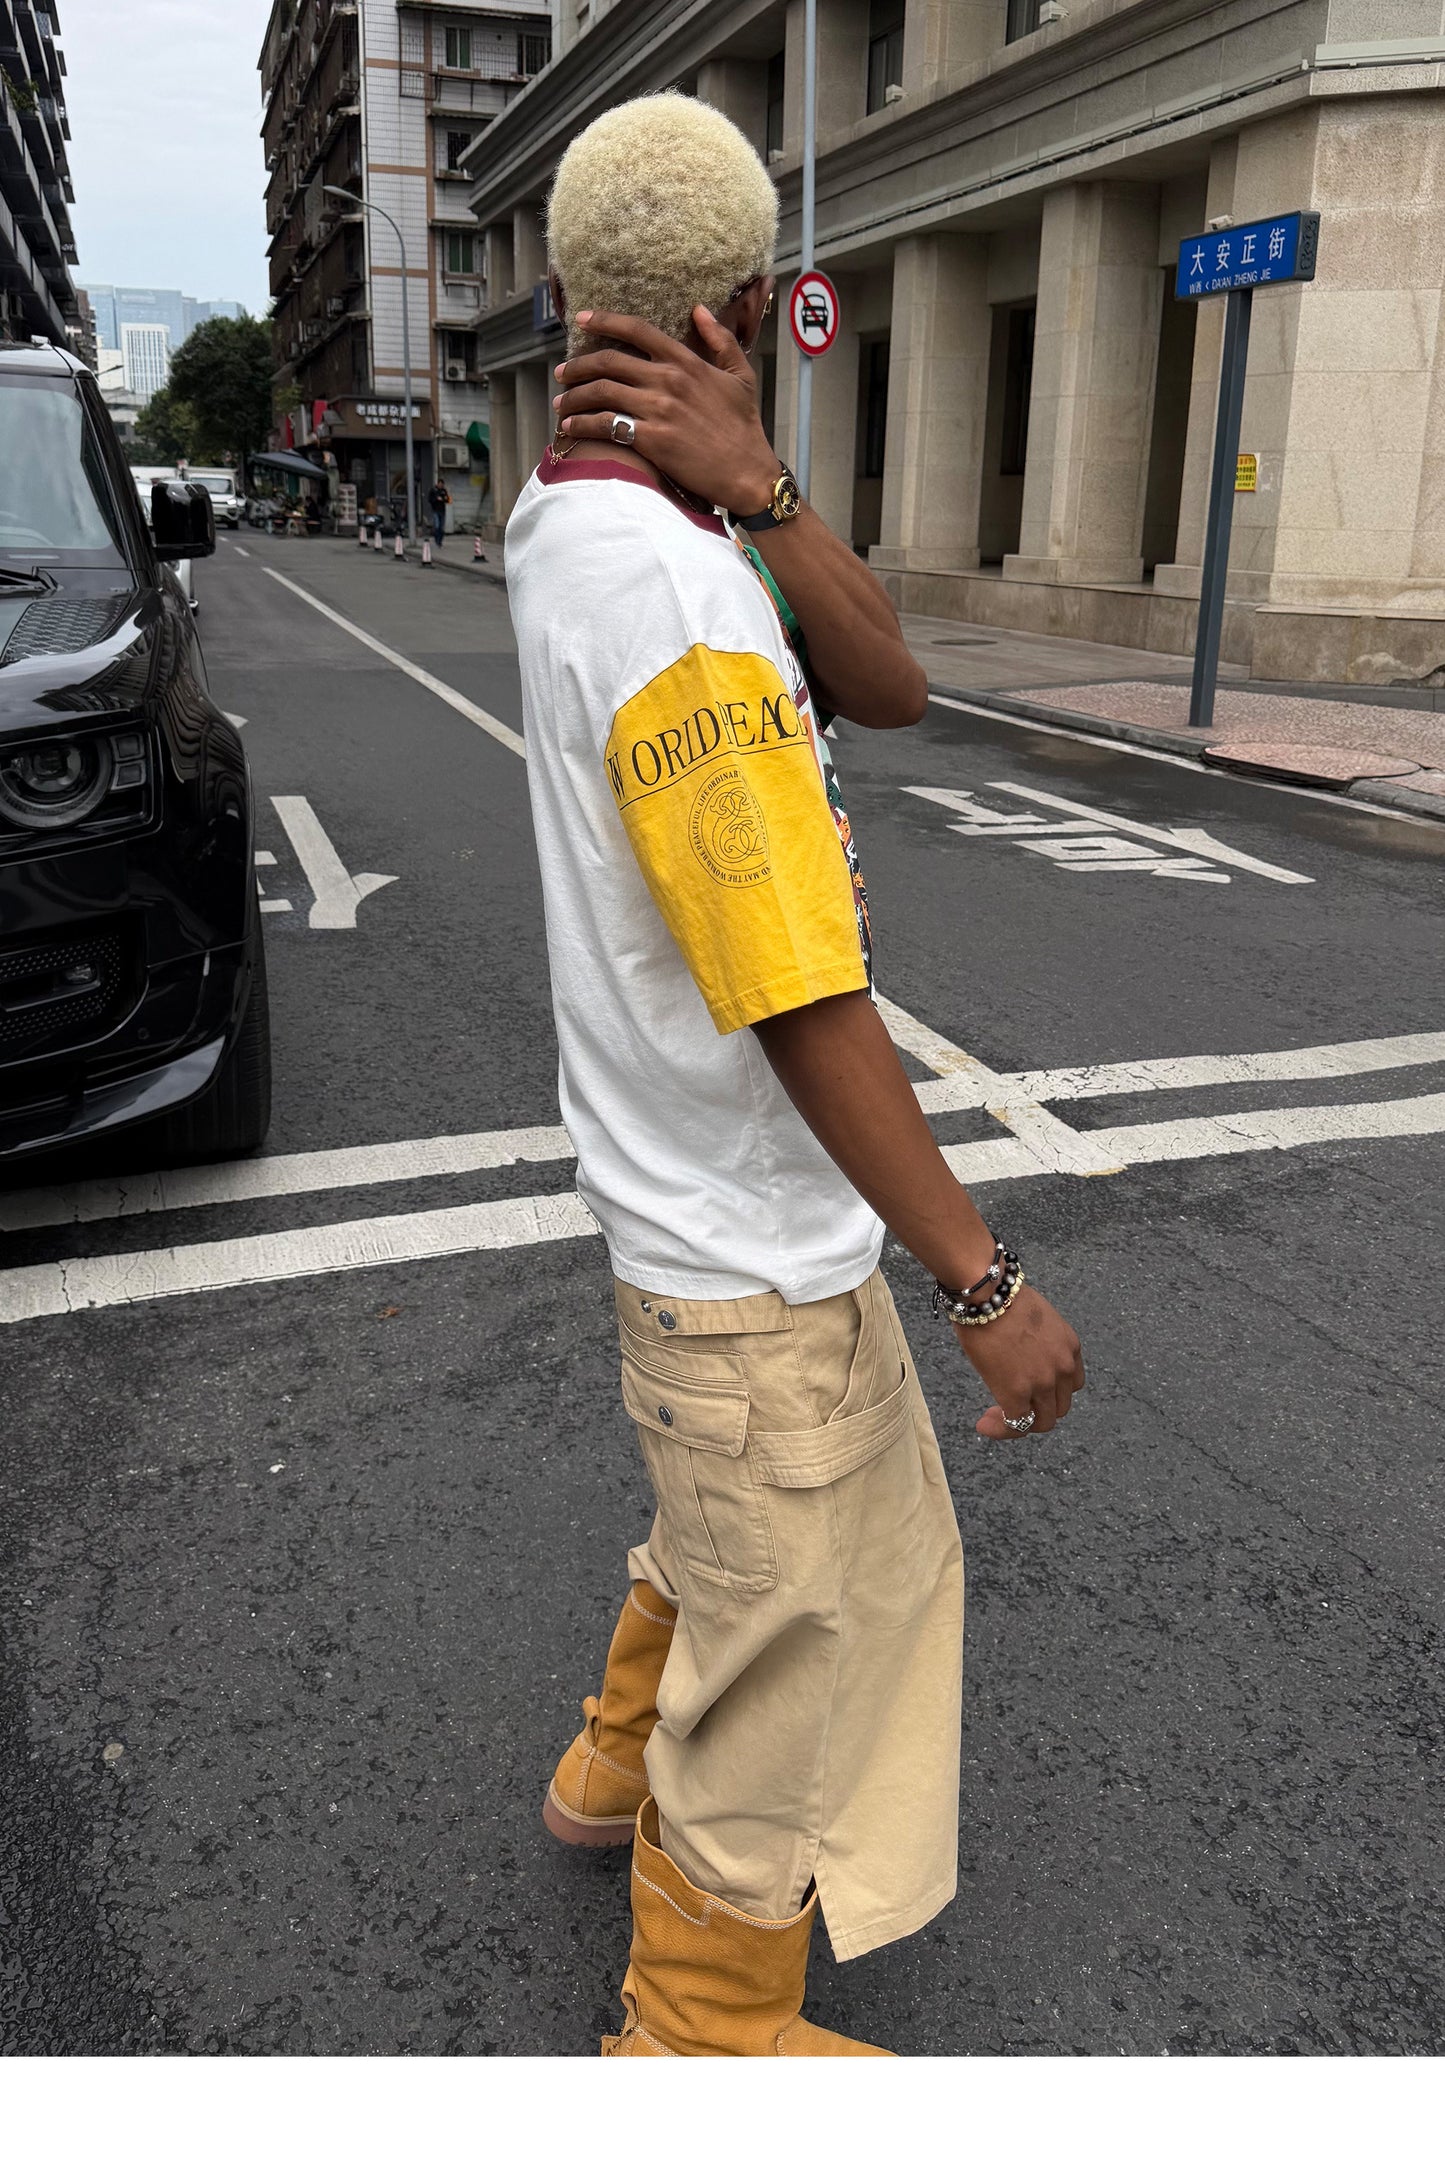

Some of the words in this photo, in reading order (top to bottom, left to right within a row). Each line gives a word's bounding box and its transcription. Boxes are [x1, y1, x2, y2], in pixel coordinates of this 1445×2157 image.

[1190, 227, 1286, 277] 大安正街
[1234, 270, 1258, 286] ZHENG
[1260, 267, 1272, 281] JIE
[707, 770, 739, 791] ORDINAR
[698, 788, 710, 808] LIFE
[706, 859, 727, 881] WORLD
[727, 874, 741, 884] THE
[743, 872, 760, 883] MAY
